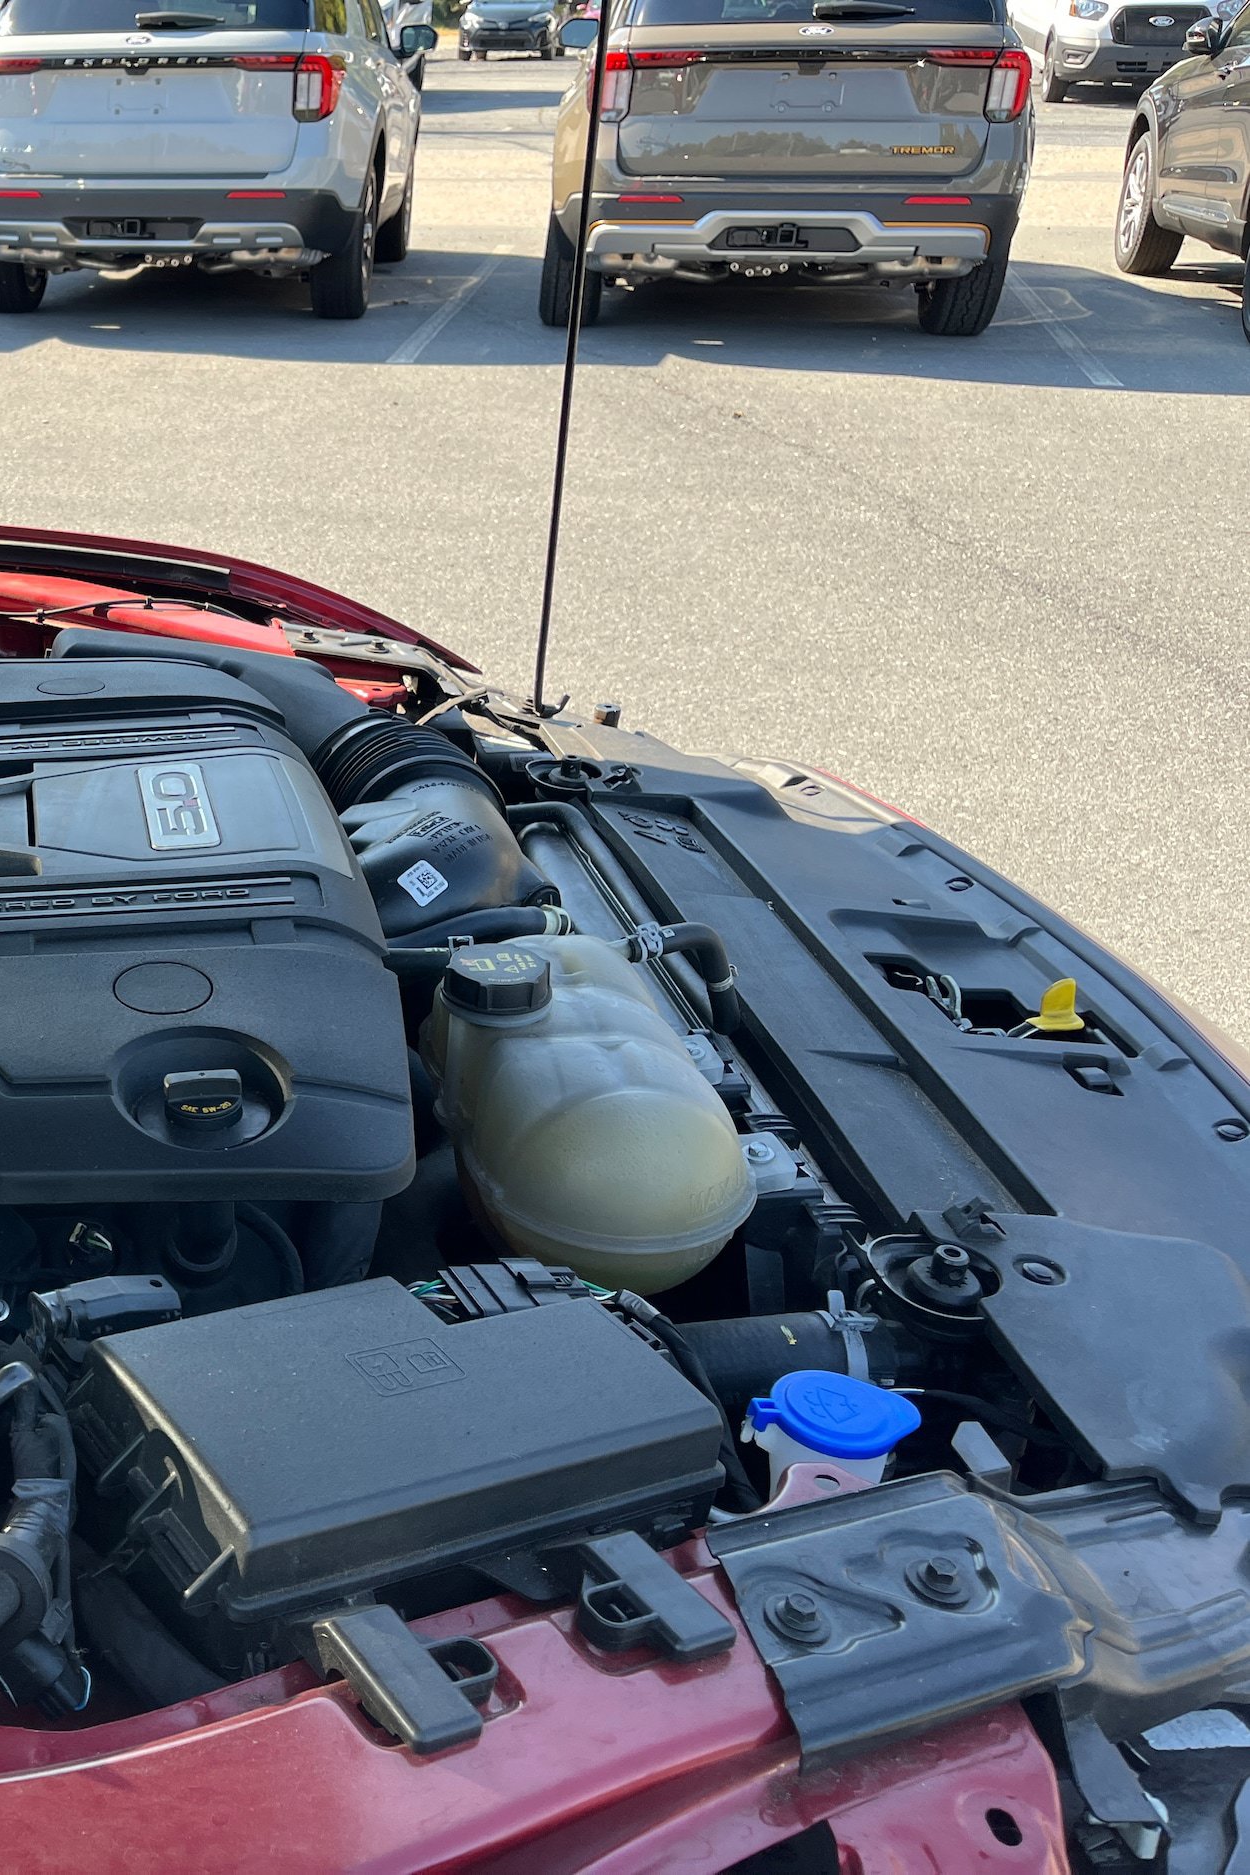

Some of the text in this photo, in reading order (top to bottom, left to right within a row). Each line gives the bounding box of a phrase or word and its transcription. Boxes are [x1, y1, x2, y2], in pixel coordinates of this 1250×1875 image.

[63, 57, 209, 68] EXPLORER
[892, 146, 955, 154] TREMOR
[62, 733, 207, 746] POWERED
[91, 894, 138, 905] BY
[153, 887, 250, 901] FORD
[180, 1104, 199, 1114] SAE
